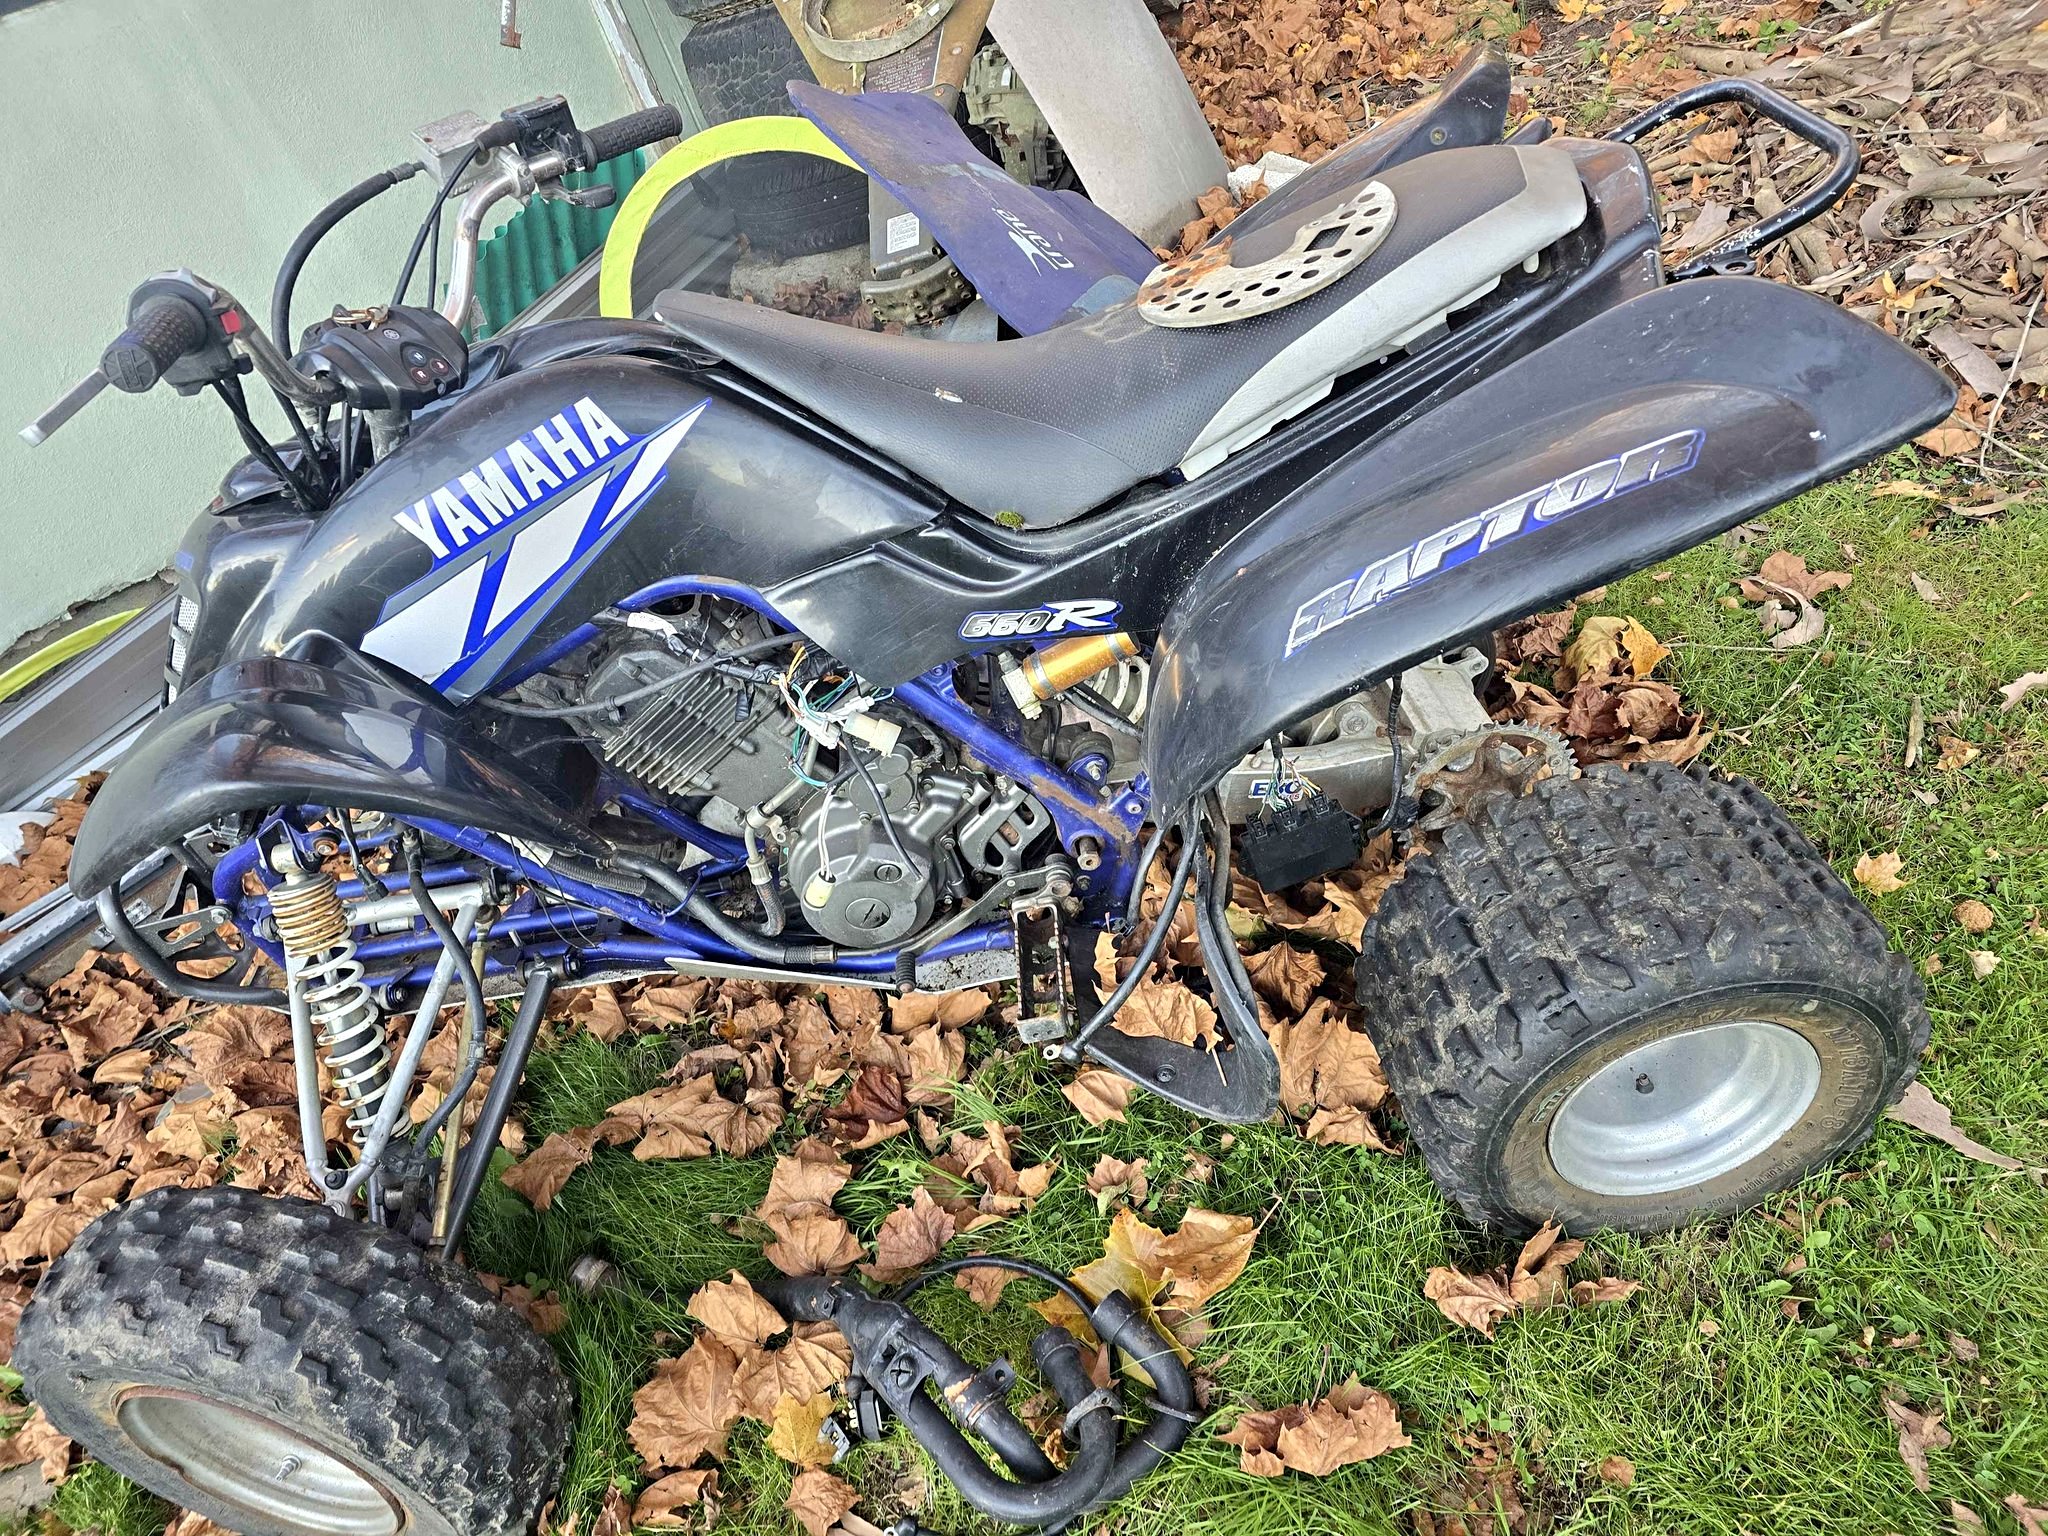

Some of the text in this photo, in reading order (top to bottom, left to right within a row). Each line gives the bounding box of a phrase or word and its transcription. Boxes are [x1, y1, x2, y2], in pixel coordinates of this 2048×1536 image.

[994, 208, 1075, 270] crane
[393, 396, 630, 559] YAMAHA
[1284, 428, 1703, 659] RAPTOR
[961, 600, 1118, 638] 660R
